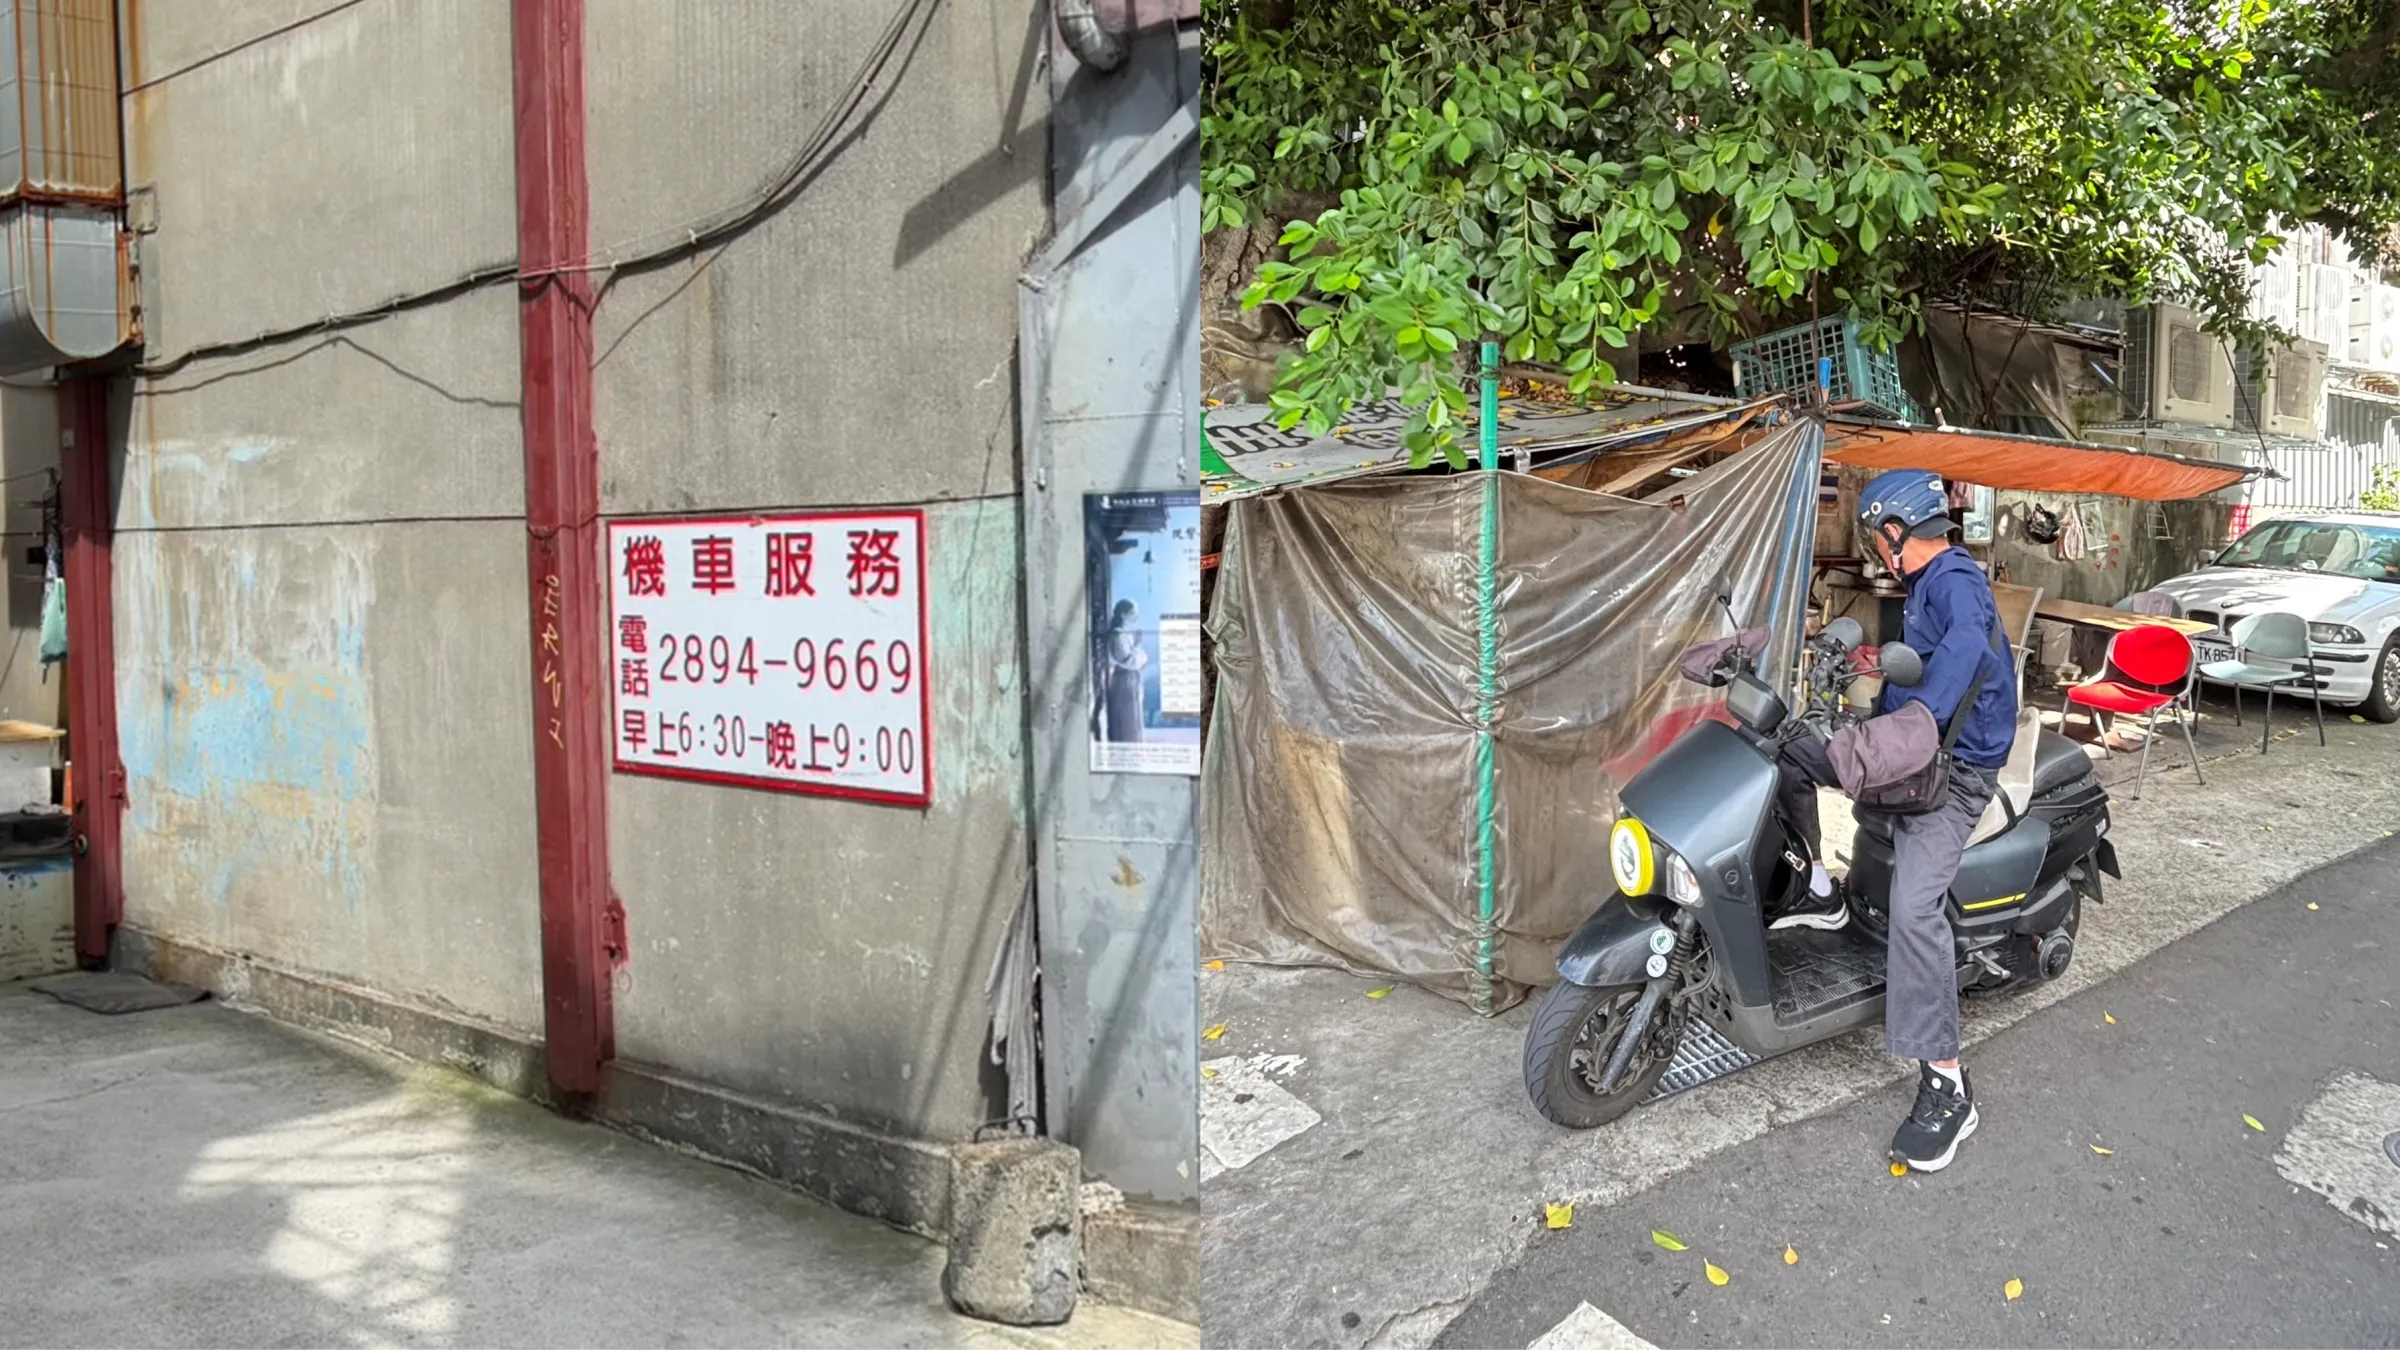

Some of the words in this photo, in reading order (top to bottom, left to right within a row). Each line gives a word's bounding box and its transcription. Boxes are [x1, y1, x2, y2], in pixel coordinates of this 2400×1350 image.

[622, 528, 901, 597] 機車服務
[618, 614, 649, 698] 電話
[658, 633, 912, 694] 2894-9669
[622, 708, 915, 775] 早上6:30-晚上9:00
